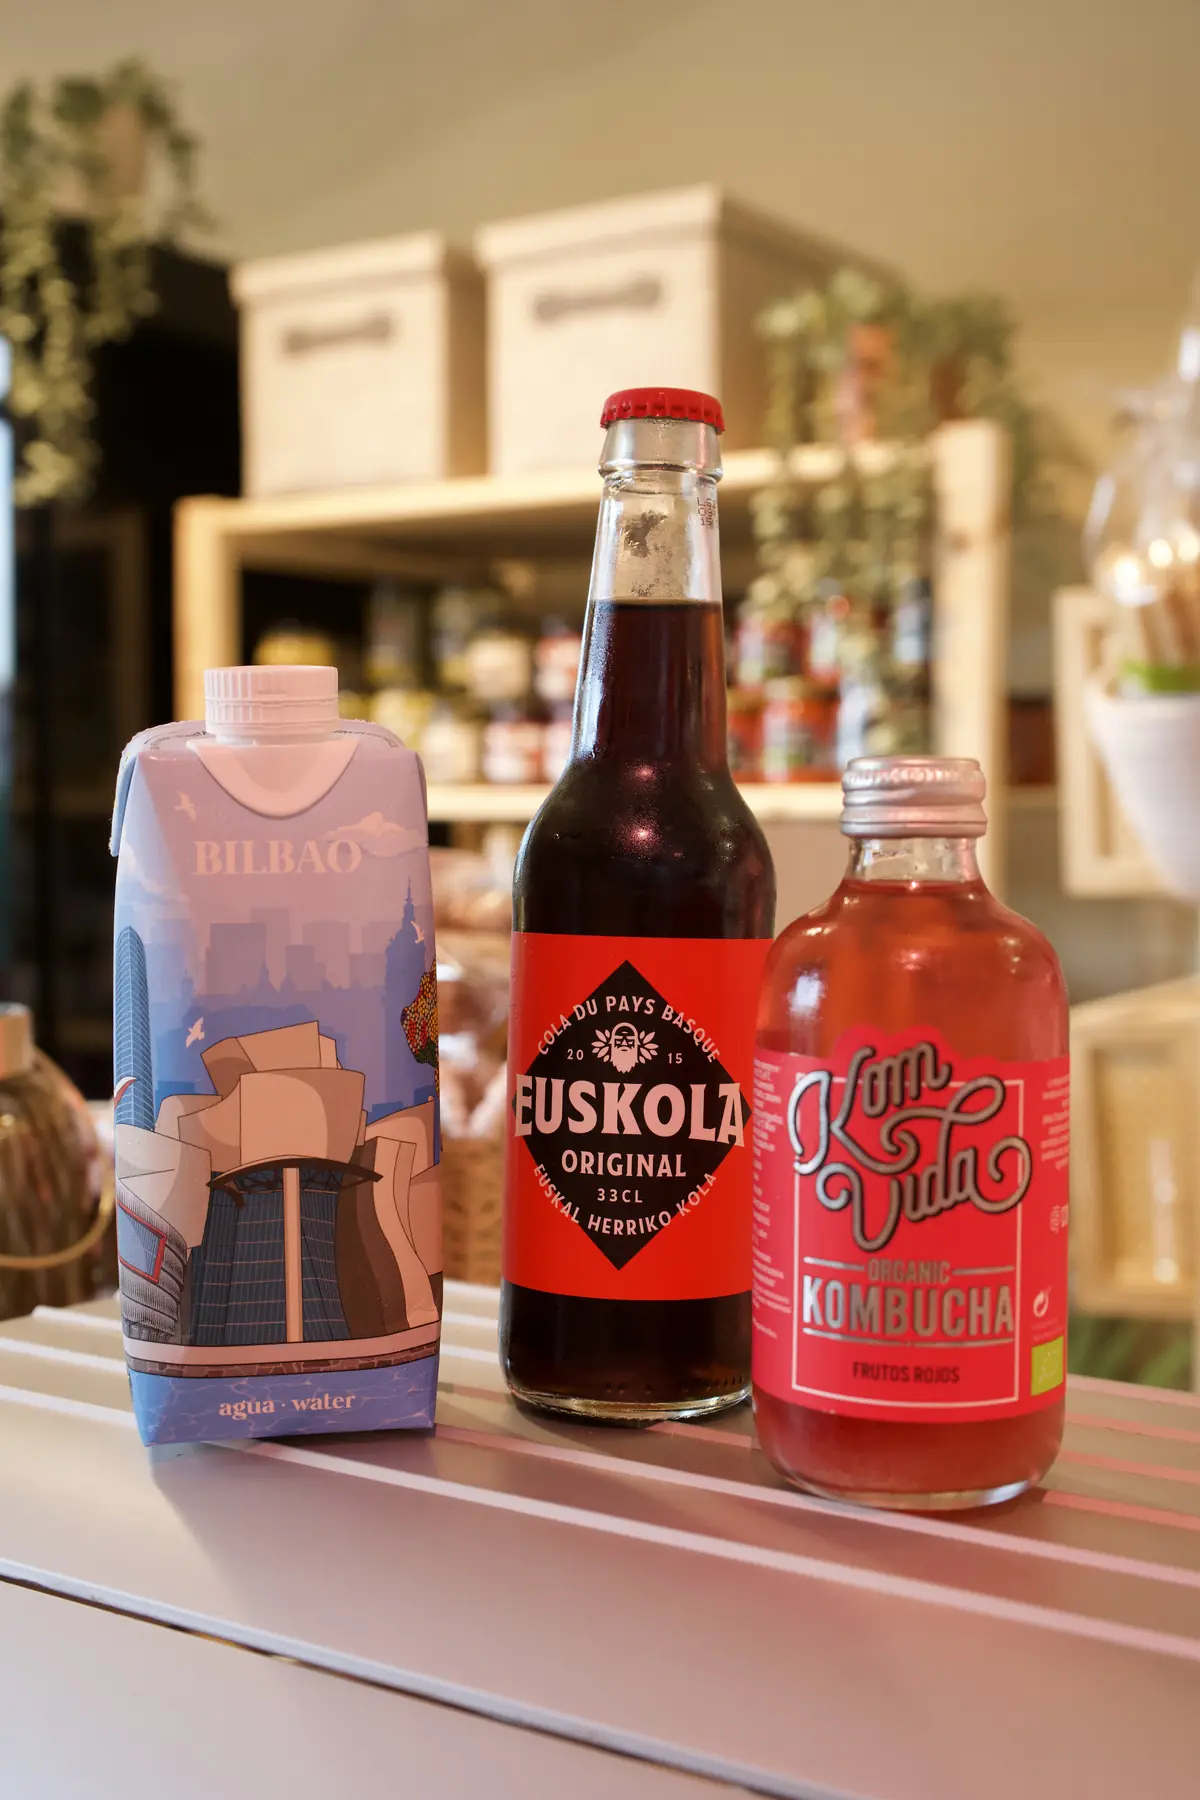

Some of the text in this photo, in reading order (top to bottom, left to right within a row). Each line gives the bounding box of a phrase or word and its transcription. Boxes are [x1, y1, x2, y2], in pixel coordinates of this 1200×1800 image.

[190, 839, 362, 875] BILBAO
[537, 995, 721, 1064] COLA DU PAYS BASQUE
[567, 1048, 683, 1064] 20 15
[514, 1073, 745, 1147] EUSKOLA
[561, 1149, 687, 1178] ORIGINAL
[534, 1163, 717, 1236] EUSKAL HERRIKO KOLA
[597, 1188, 643, 1203] 33CL
[867, 1257, 950, 1284] ORGANIC
[802, 1274, 1015, 1337] KOMBUCHA
[853, 1361, 960, 1384] FRUTOS ROJOS
[219, 1393, 356, 1420] agua water
